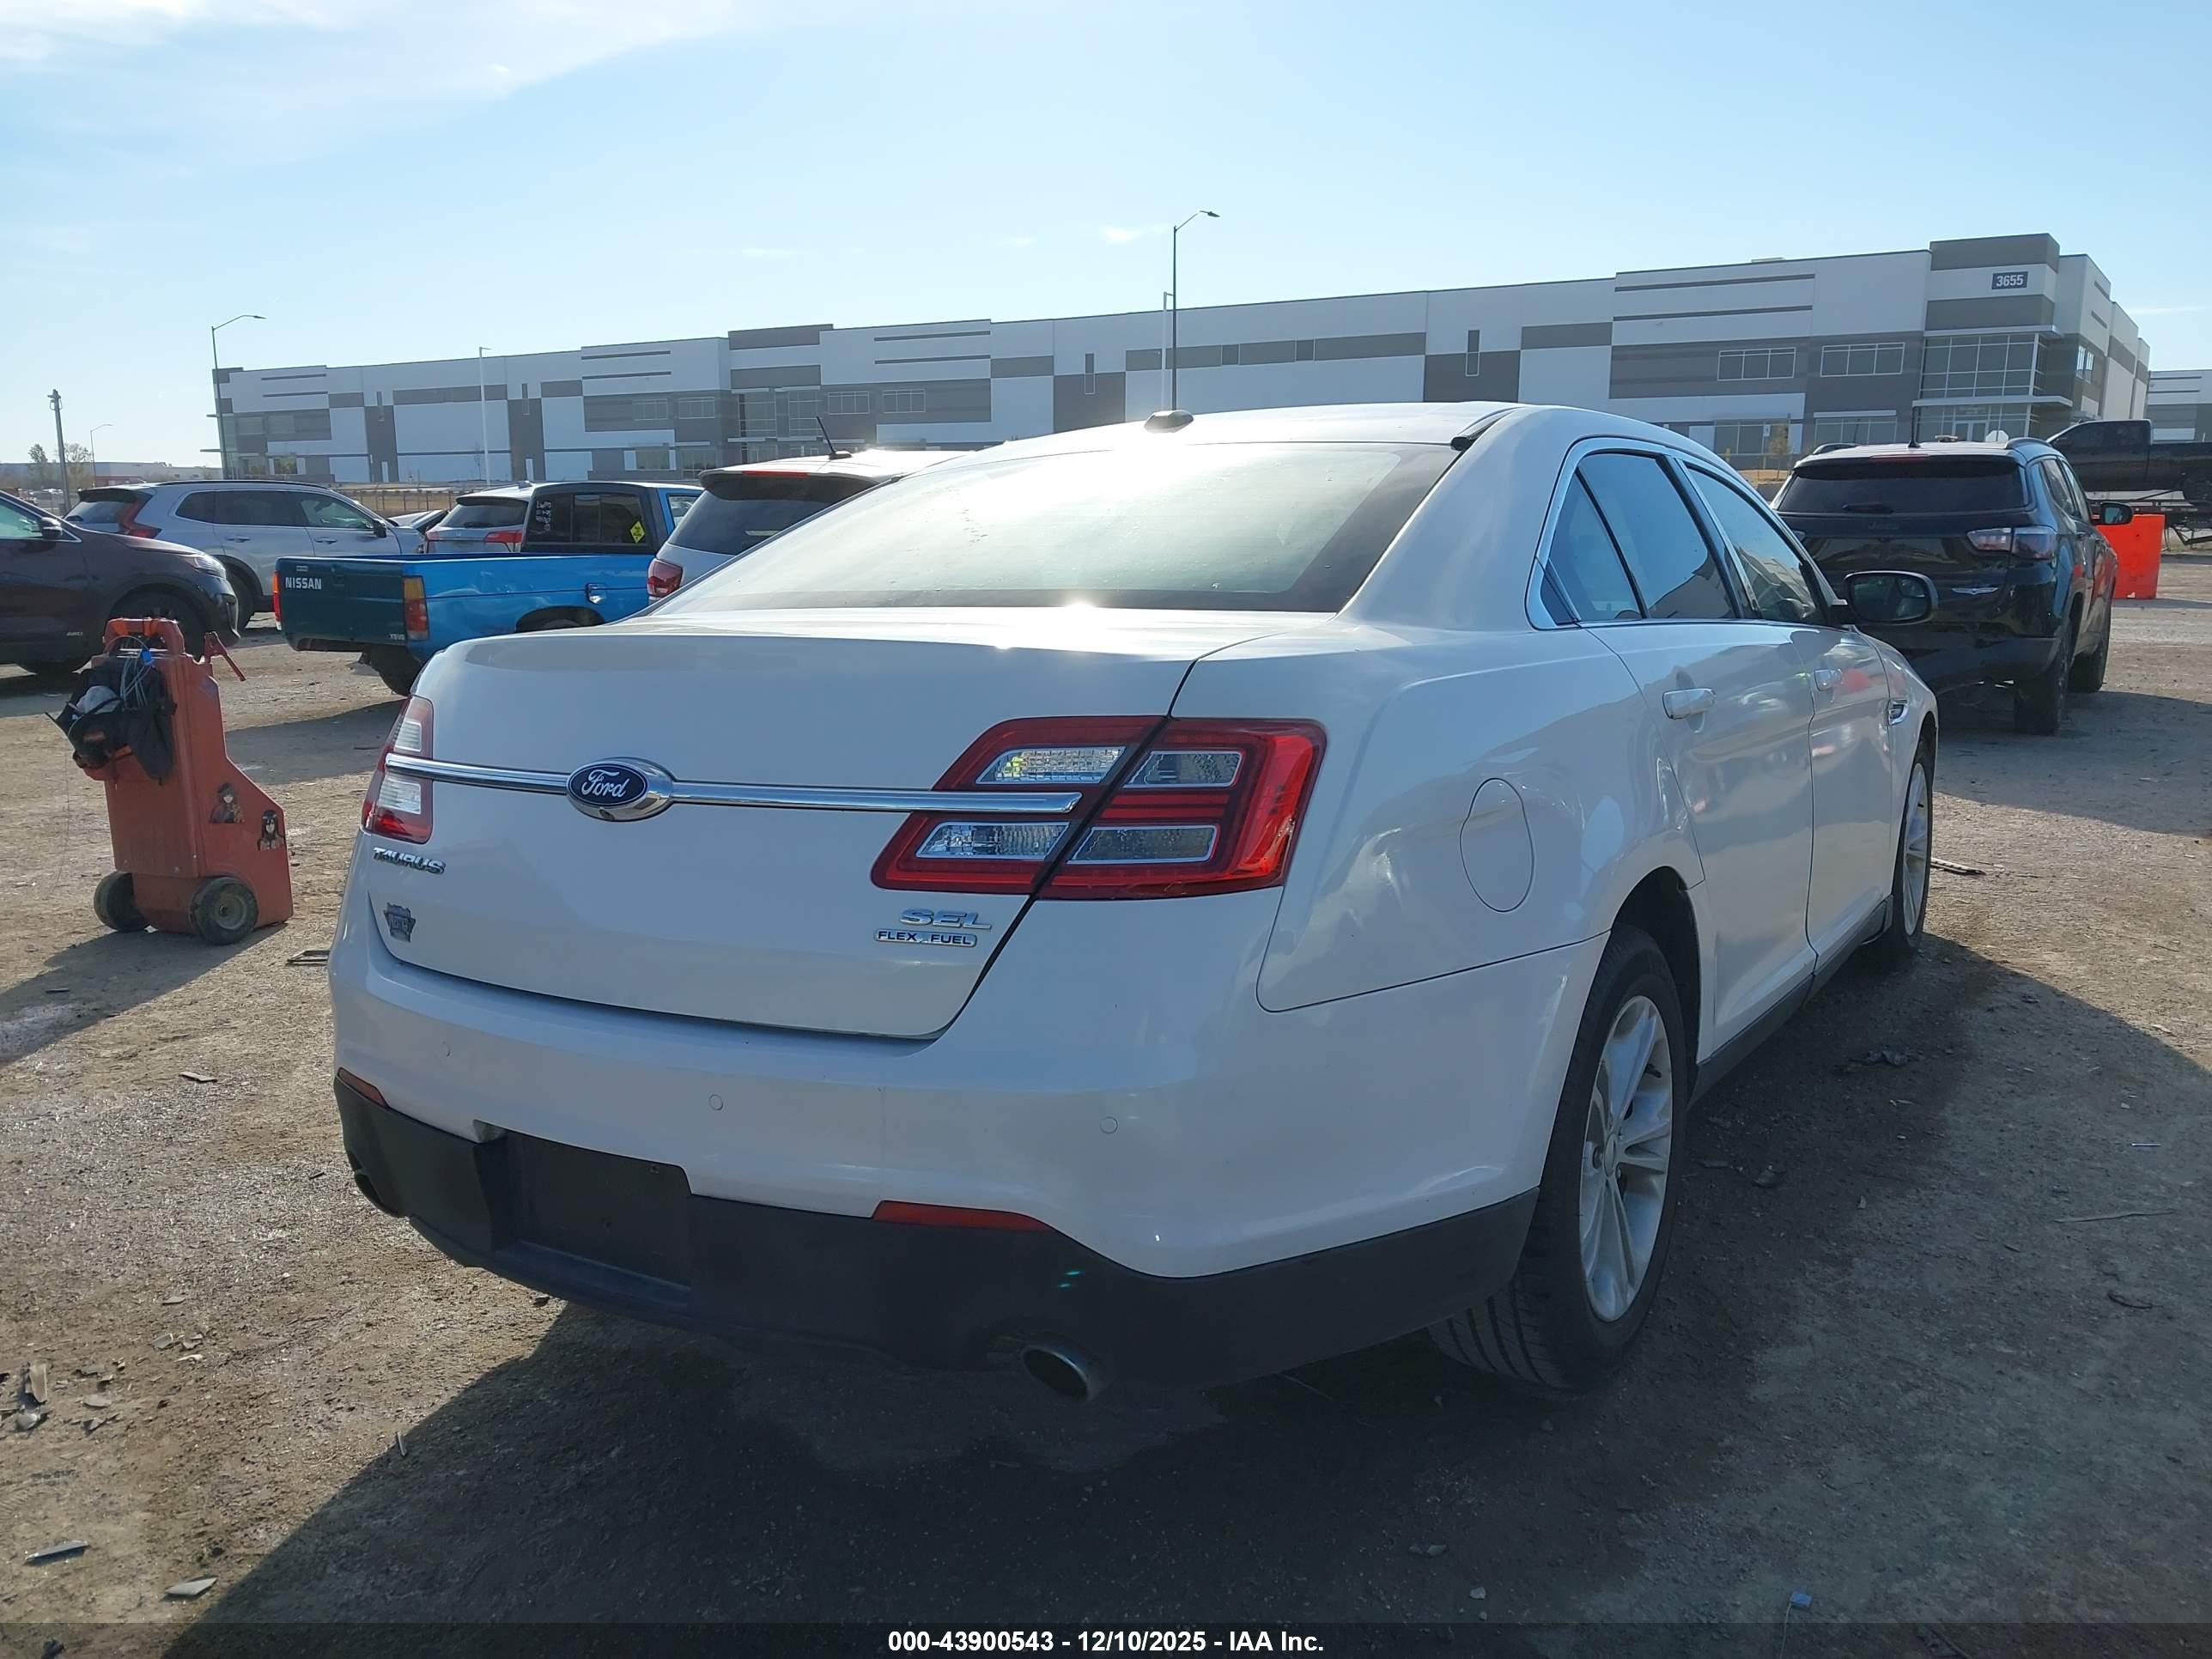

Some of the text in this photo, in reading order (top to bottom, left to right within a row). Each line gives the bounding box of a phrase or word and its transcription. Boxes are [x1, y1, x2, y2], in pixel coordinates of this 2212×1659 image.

[1996, 275, 2024, 287] 3655
[285, 577, 322, 590] NISSAN
[581, 769, 630, 798] Ford
[373, 847, 447, 875] TAURUS
[900, 908, 993, 929] SEL
[878, 931, 971, 945] FLEX FUEL
